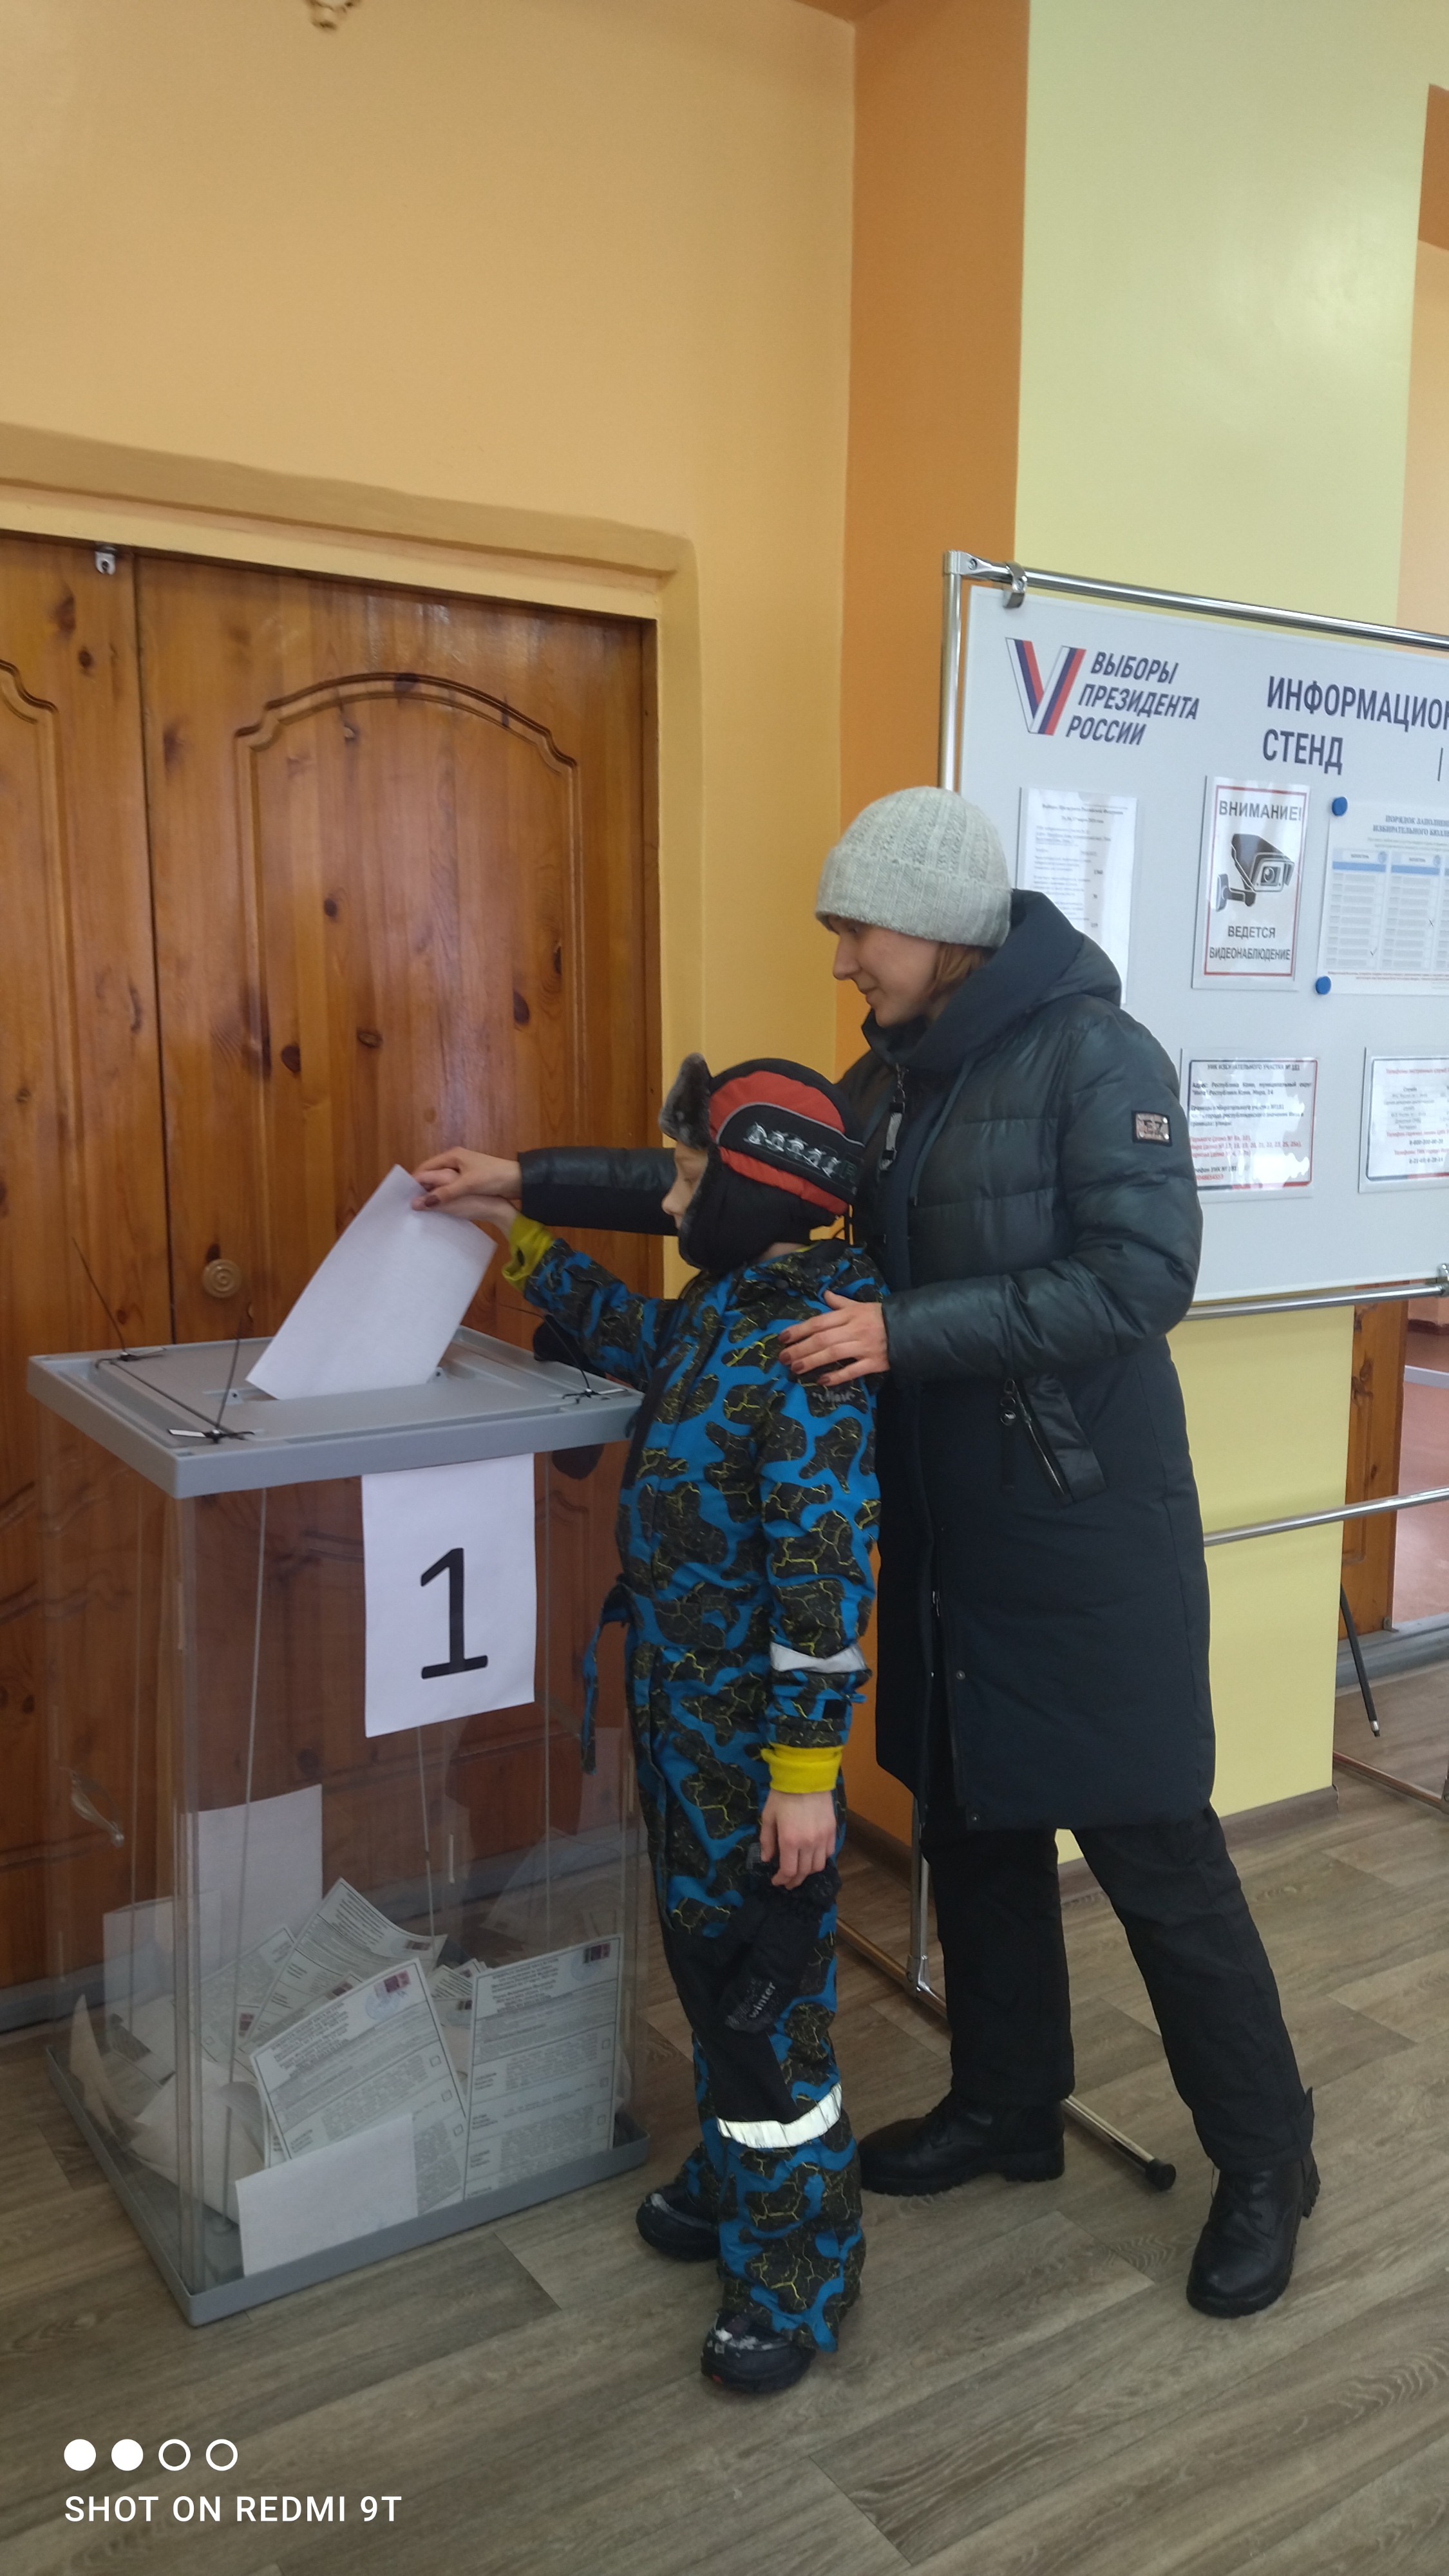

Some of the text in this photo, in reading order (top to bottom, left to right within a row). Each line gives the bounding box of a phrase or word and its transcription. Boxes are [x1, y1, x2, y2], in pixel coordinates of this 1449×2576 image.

[1090, 651, 1179, 684] ВЫБОРЫ
[1078, 683, 1200, 719] ПРЕЗИДЕНТА
[1066, 715, 1147, 746] РОССИИ
[1262, 728, 1343, 775] СТЕНД
[1219, 800, 1302, 821] ВНИМАНИЕ!
[1228, 925, 1276, 940] ВЕДЕТСЯ
[1209, 946, 1291, 962] ВИДЕОНАБЛЮДЕНИЕ
[421, 1548, 488, 1680] 1
[749, 1981, 776, 2020] winter
